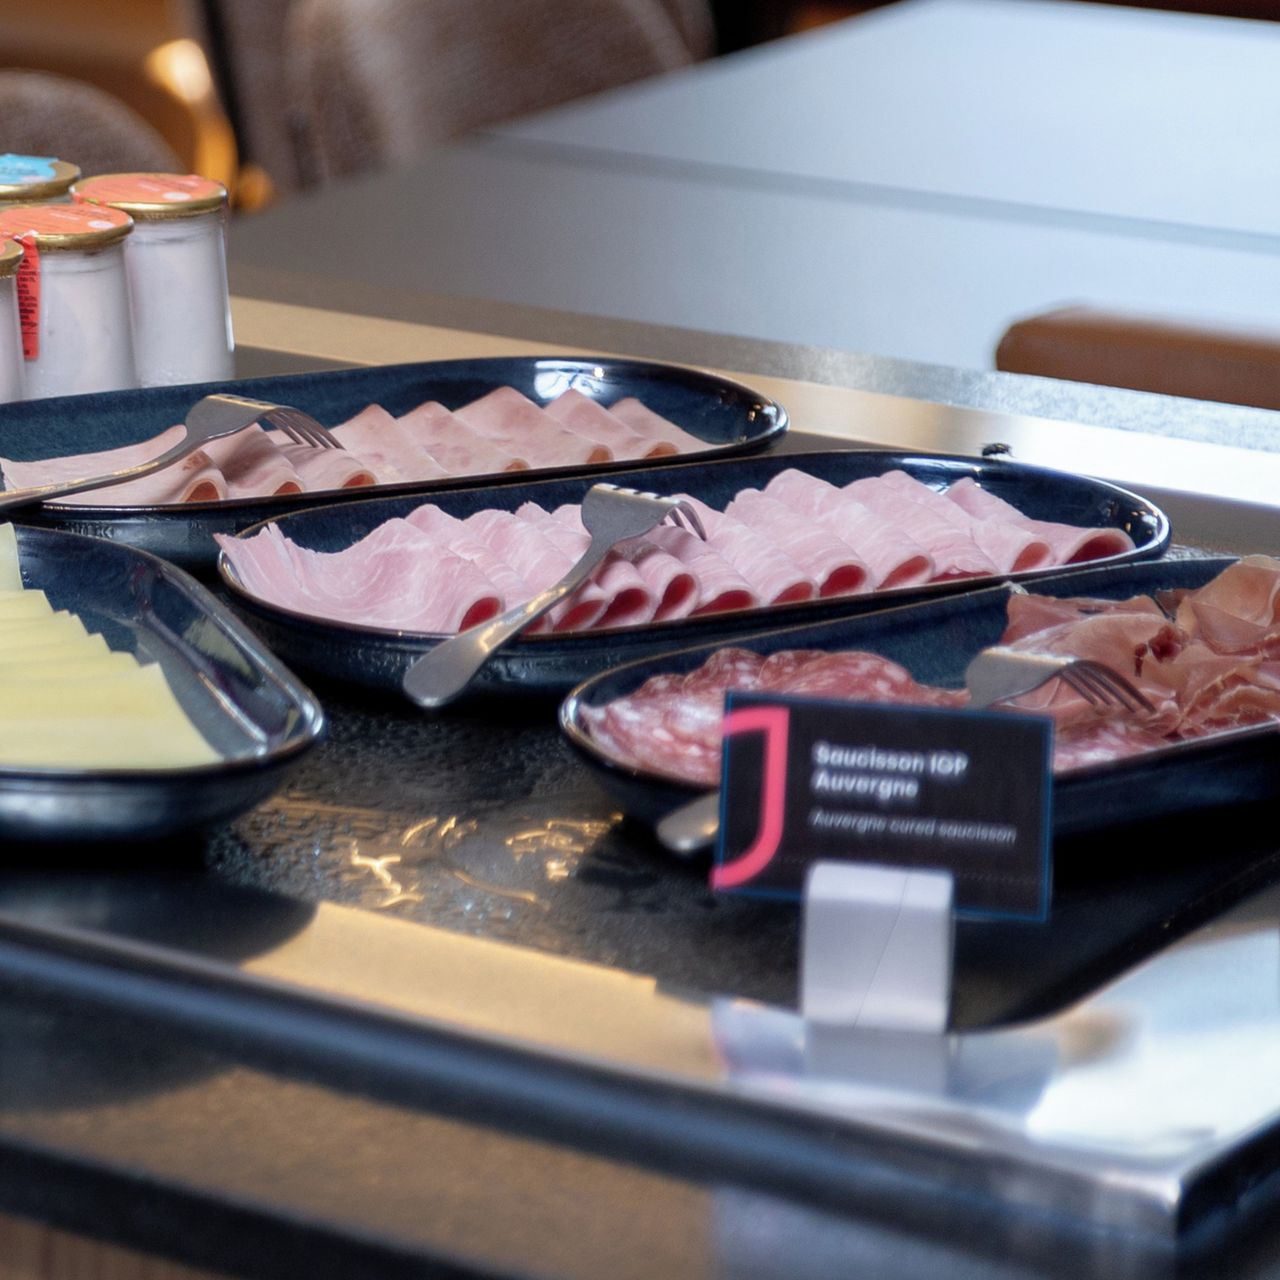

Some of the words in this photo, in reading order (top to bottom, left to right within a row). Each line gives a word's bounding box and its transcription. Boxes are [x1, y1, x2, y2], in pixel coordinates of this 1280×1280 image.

[814, 742, 926, 773] Saucisson
[930, 750, 969, 777] IGP
[813, 771, 919, 800] Auvergne
[813, 808, 887, 833] Auvergne
[890, 819, 937, 836] cured
[938, 823, 1017, 844] saucisson
